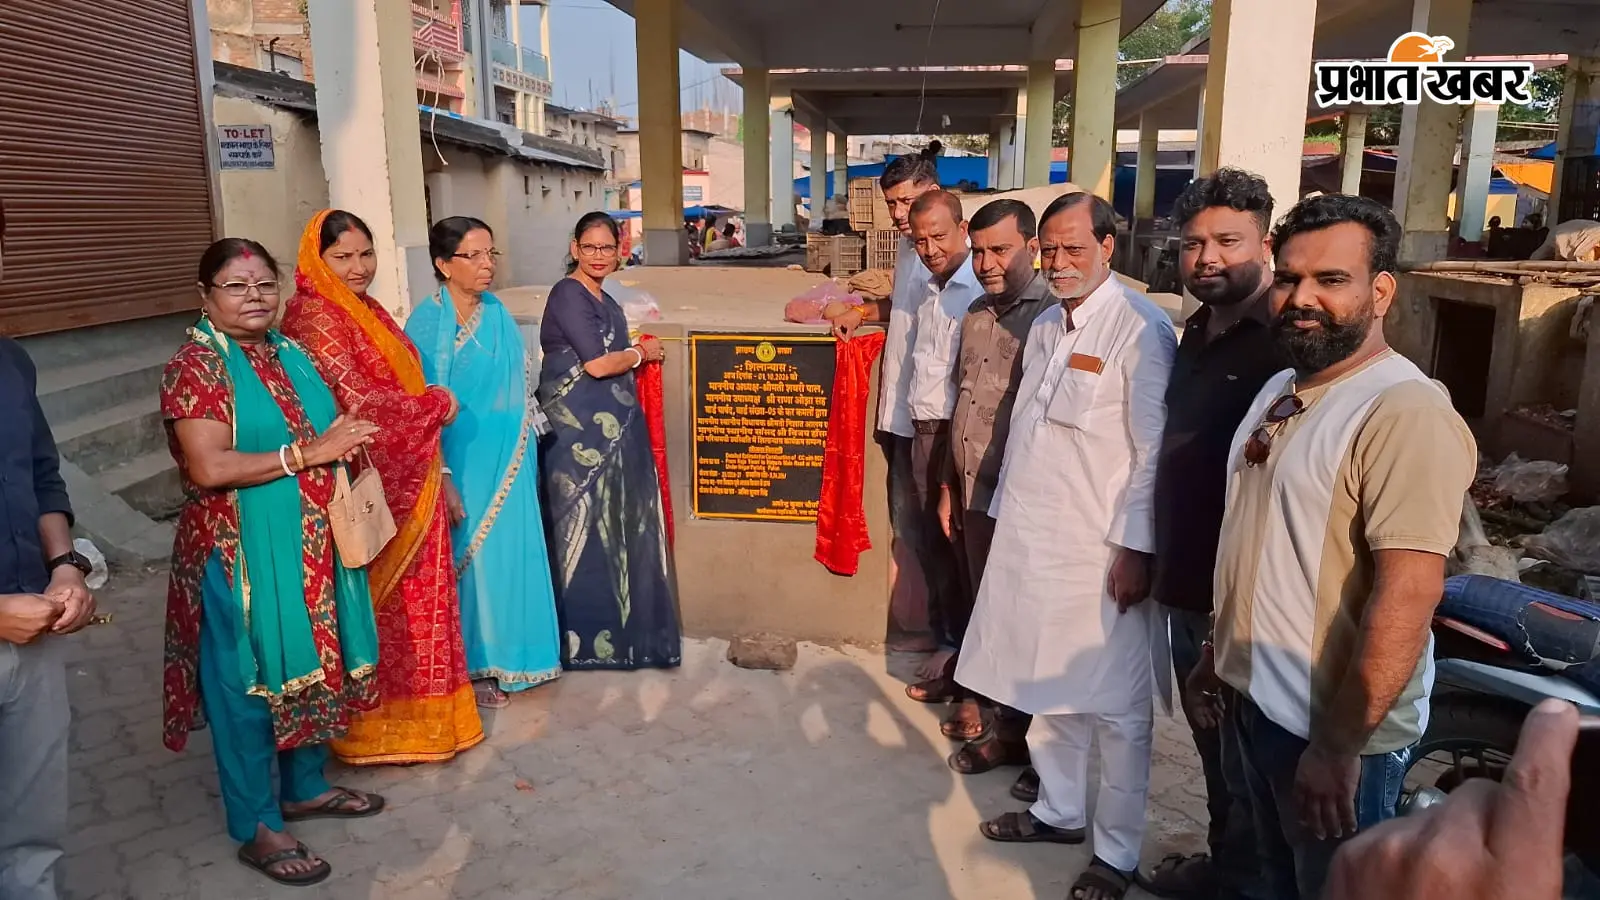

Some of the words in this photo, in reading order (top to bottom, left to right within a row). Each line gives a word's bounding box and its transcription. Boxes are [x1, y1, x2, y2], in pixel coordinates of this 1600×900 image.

[744, 360, 787, 372] शिलान्यास
[708, 380, 735, 391] माननीय
[704, 391, 732, 403] माननीय
[732, 393, 761, 405] उपाध्यक्ष
[766, 392, 776, 404] श्री
